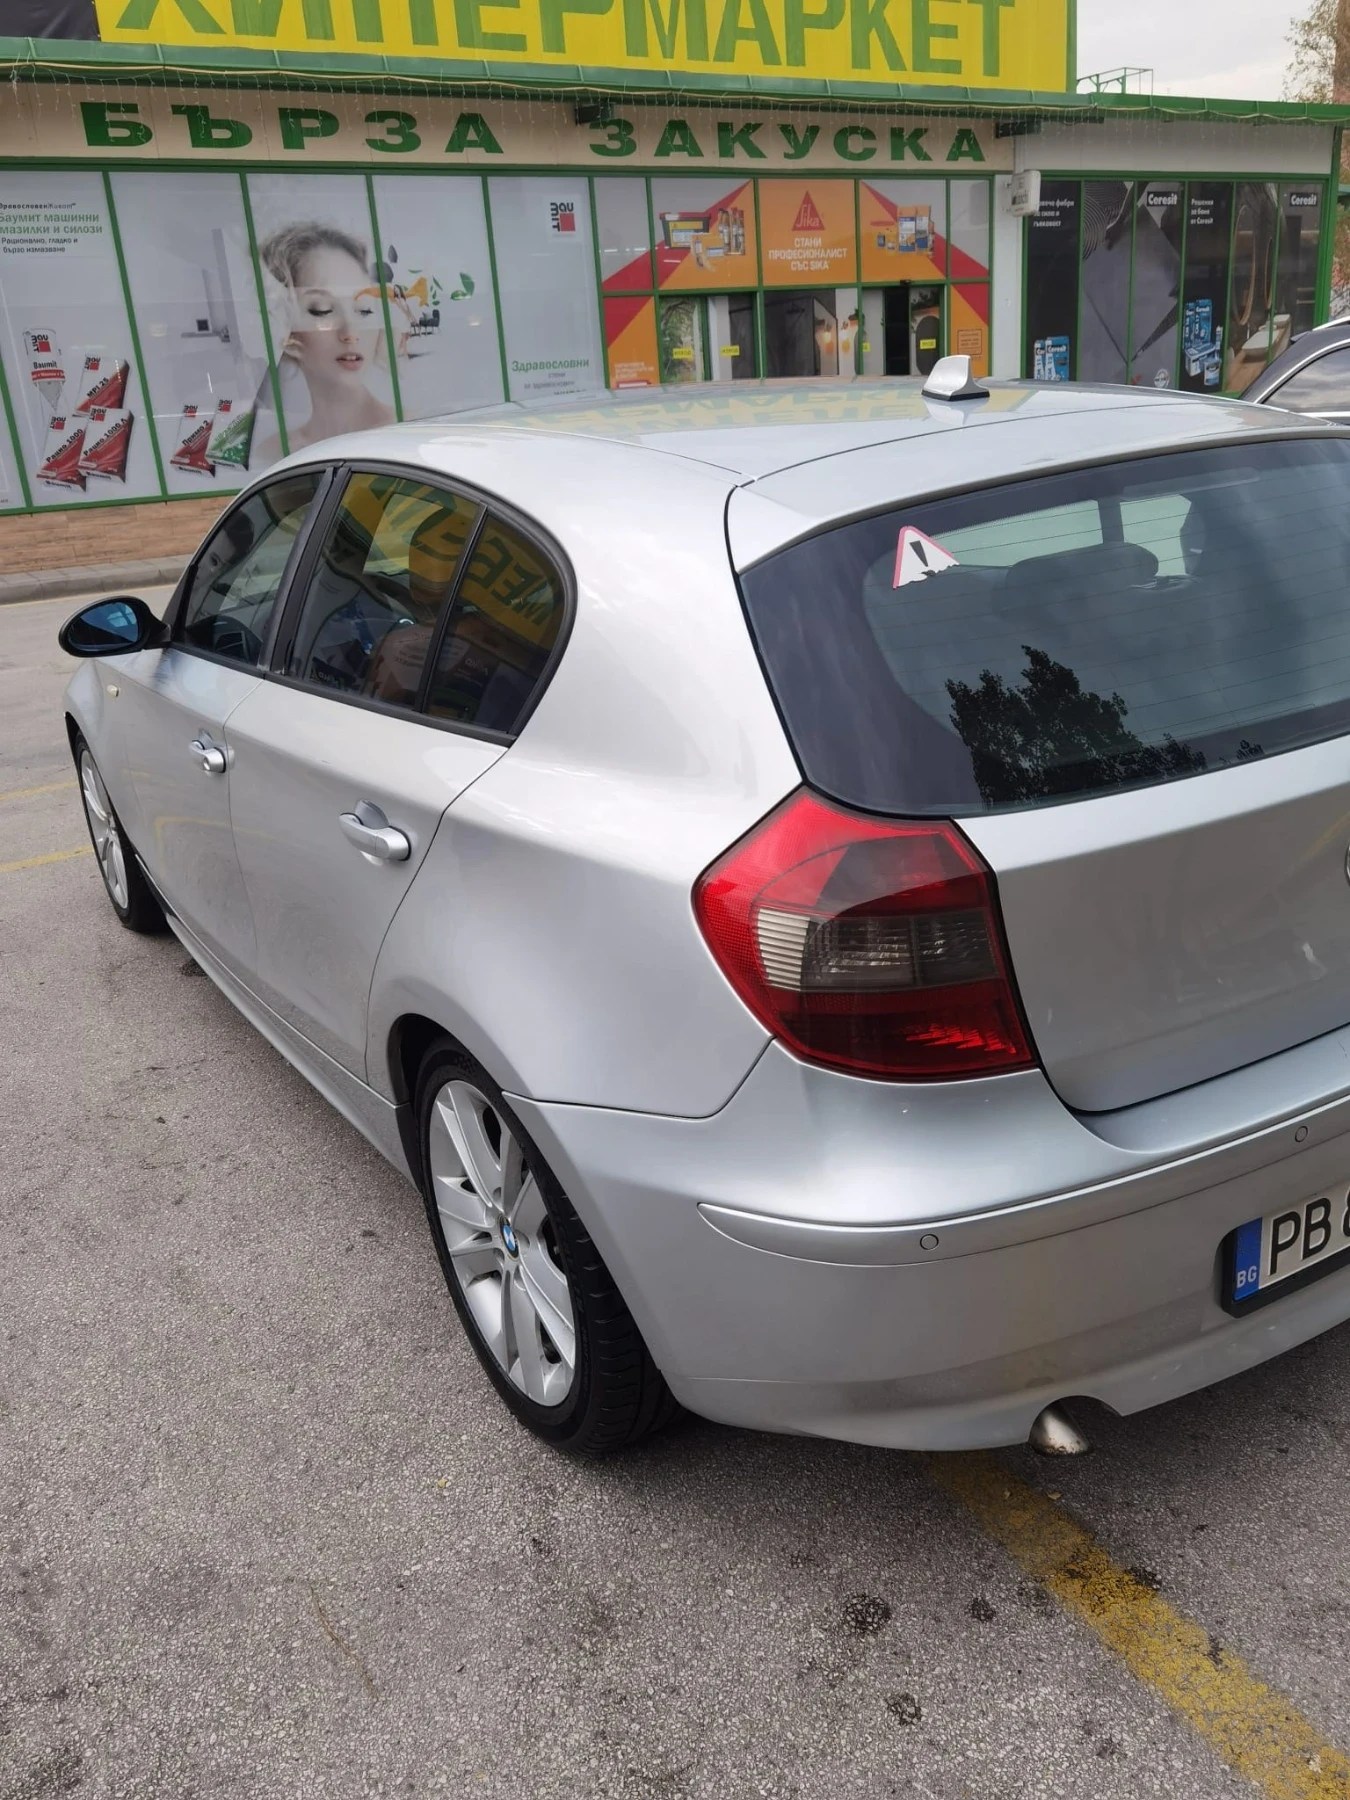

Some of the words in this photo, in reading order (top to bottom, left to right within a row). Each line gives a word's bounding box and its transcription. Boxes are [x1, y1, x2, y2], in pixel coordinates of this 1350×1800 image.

[80, 102, 504, 154] БЪРЗА
[589, 118, 986, 162] ЗАКУСКА
[1148, 193, 1178, 206] Ceresit
[1291, 193, 1317, 206] Ceresit
[44, 214, 99, 222] машинни
[796, 203, 820, 228] Sika
[63, 225, 102, 234] силози
[794, 237, 822, 248] СТАНИ
[768, 248, 847, 260] ПРОФЕСИОНАЛИСТ
[33, 361, 57, 369] Baumit
[1269, 1197, 1331, 1276] PB
[1236, 1265, 1258, 1288] BG
